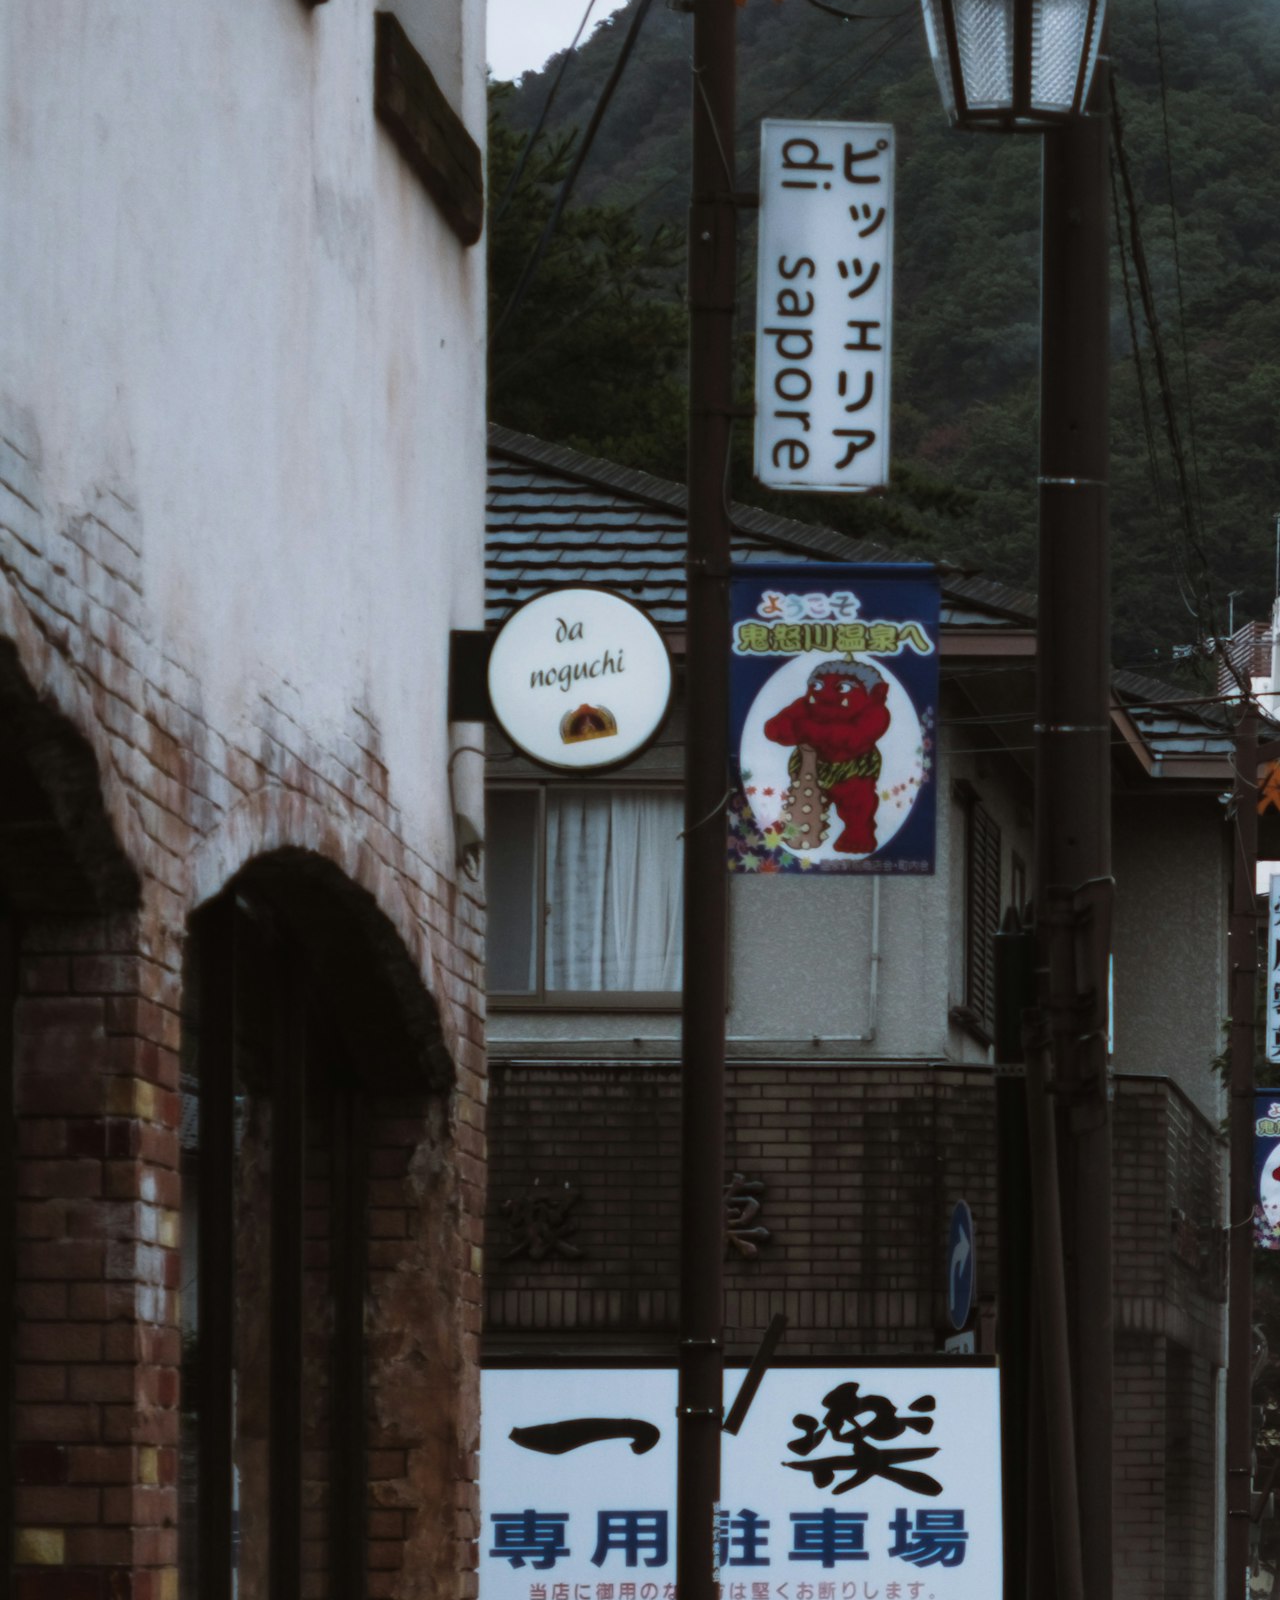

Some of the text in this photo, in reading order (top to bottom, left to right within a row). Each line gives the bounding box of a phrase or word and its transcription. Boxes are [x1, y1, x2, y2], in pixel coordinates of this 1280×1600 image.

[762, 137, 835, 471] di sapore
[831, 138, 889, 470] ピッツェリア
[759, 591, 859, 618] ようこそ
[555, 616, 584, 643] da
[736, 621, 933, 653] 鬼怒川温泉へ
[529, 648, 626, 693] noguchi
[530, 1581, 936, 1600] 当店に御用のなは堅くお断りします。
